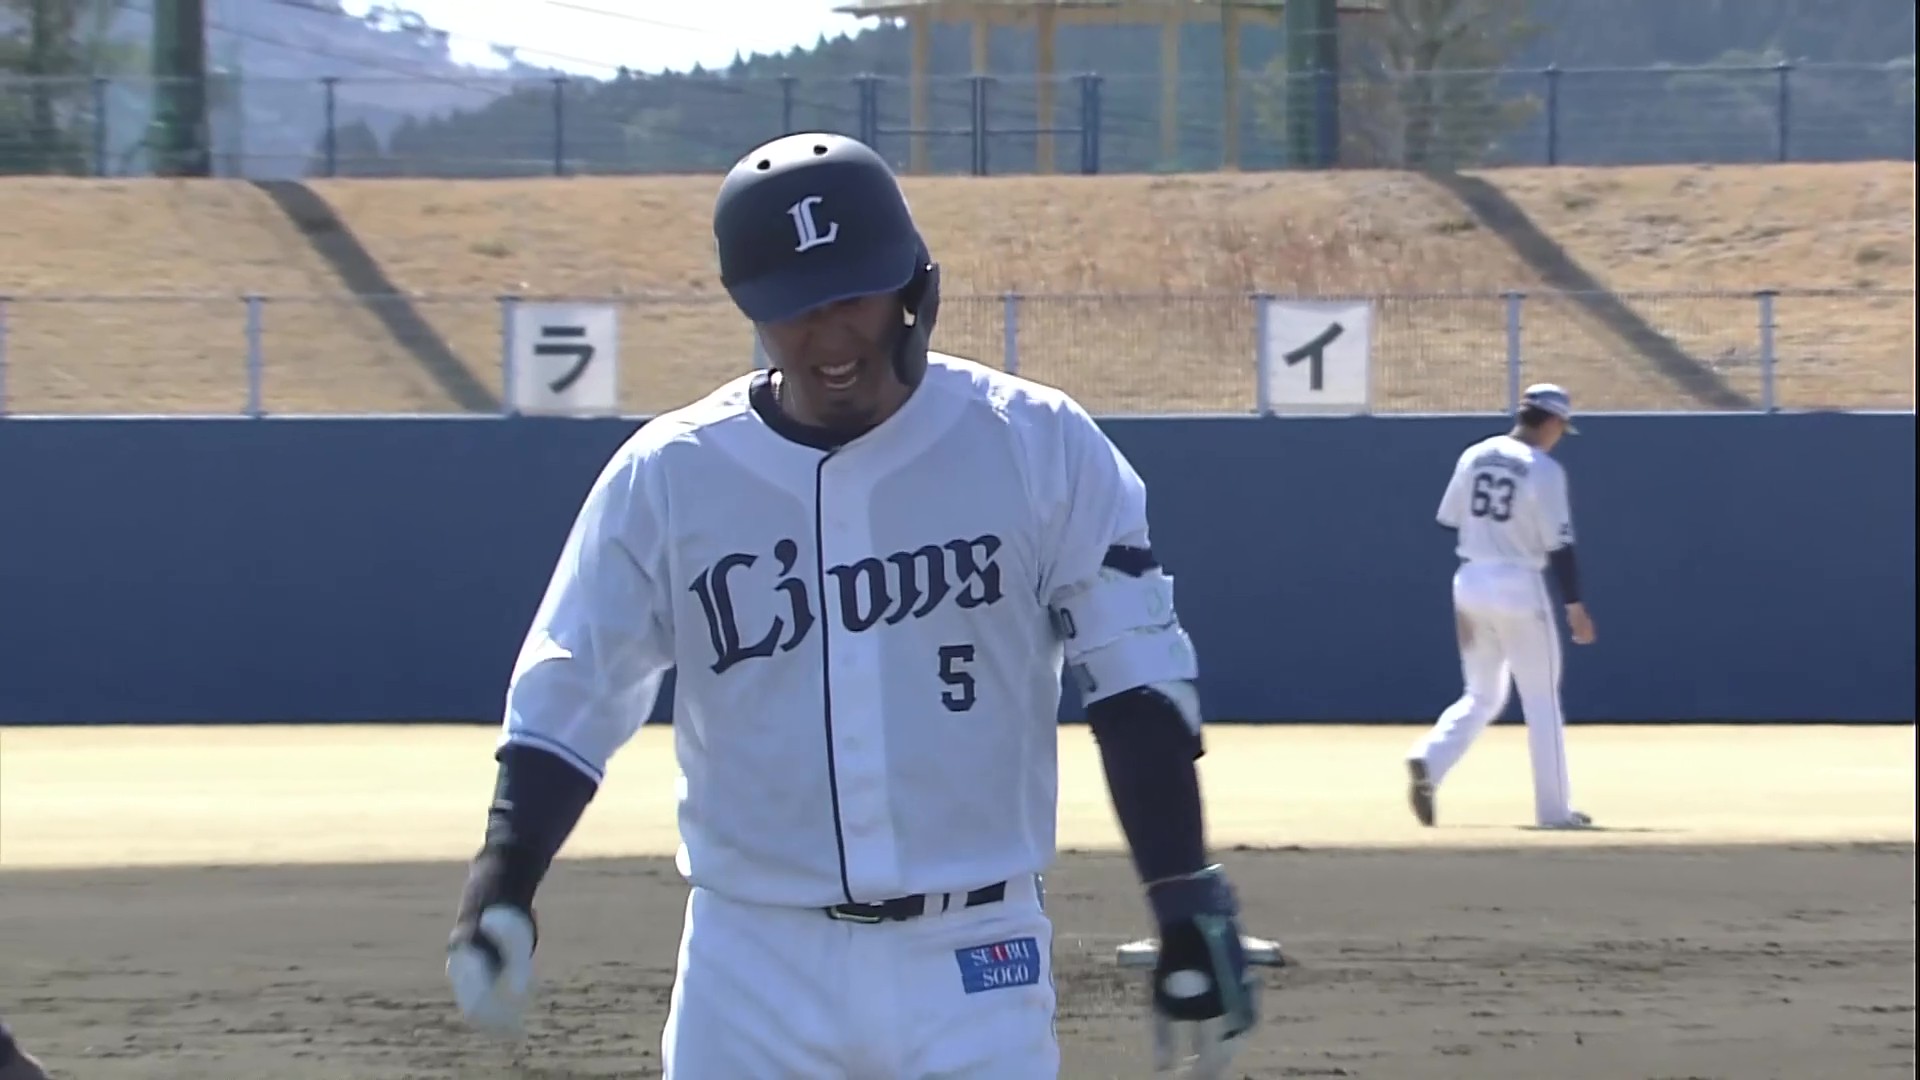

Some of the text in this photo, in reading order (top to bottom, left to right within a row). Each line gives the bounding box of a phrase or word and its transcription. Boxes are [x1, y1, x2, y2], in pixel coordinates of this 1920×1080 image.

[786, 195, 839, 252] L
[532, 326, 596, 394] ラ
[1282, 321, 1345, 391] イ
[1471, 472, 1515, 522] 63
[689, 534, 1004, 674] Lions
[938, 645, 976, 712] 5
[982, 964, 1029, 988] SOGO
